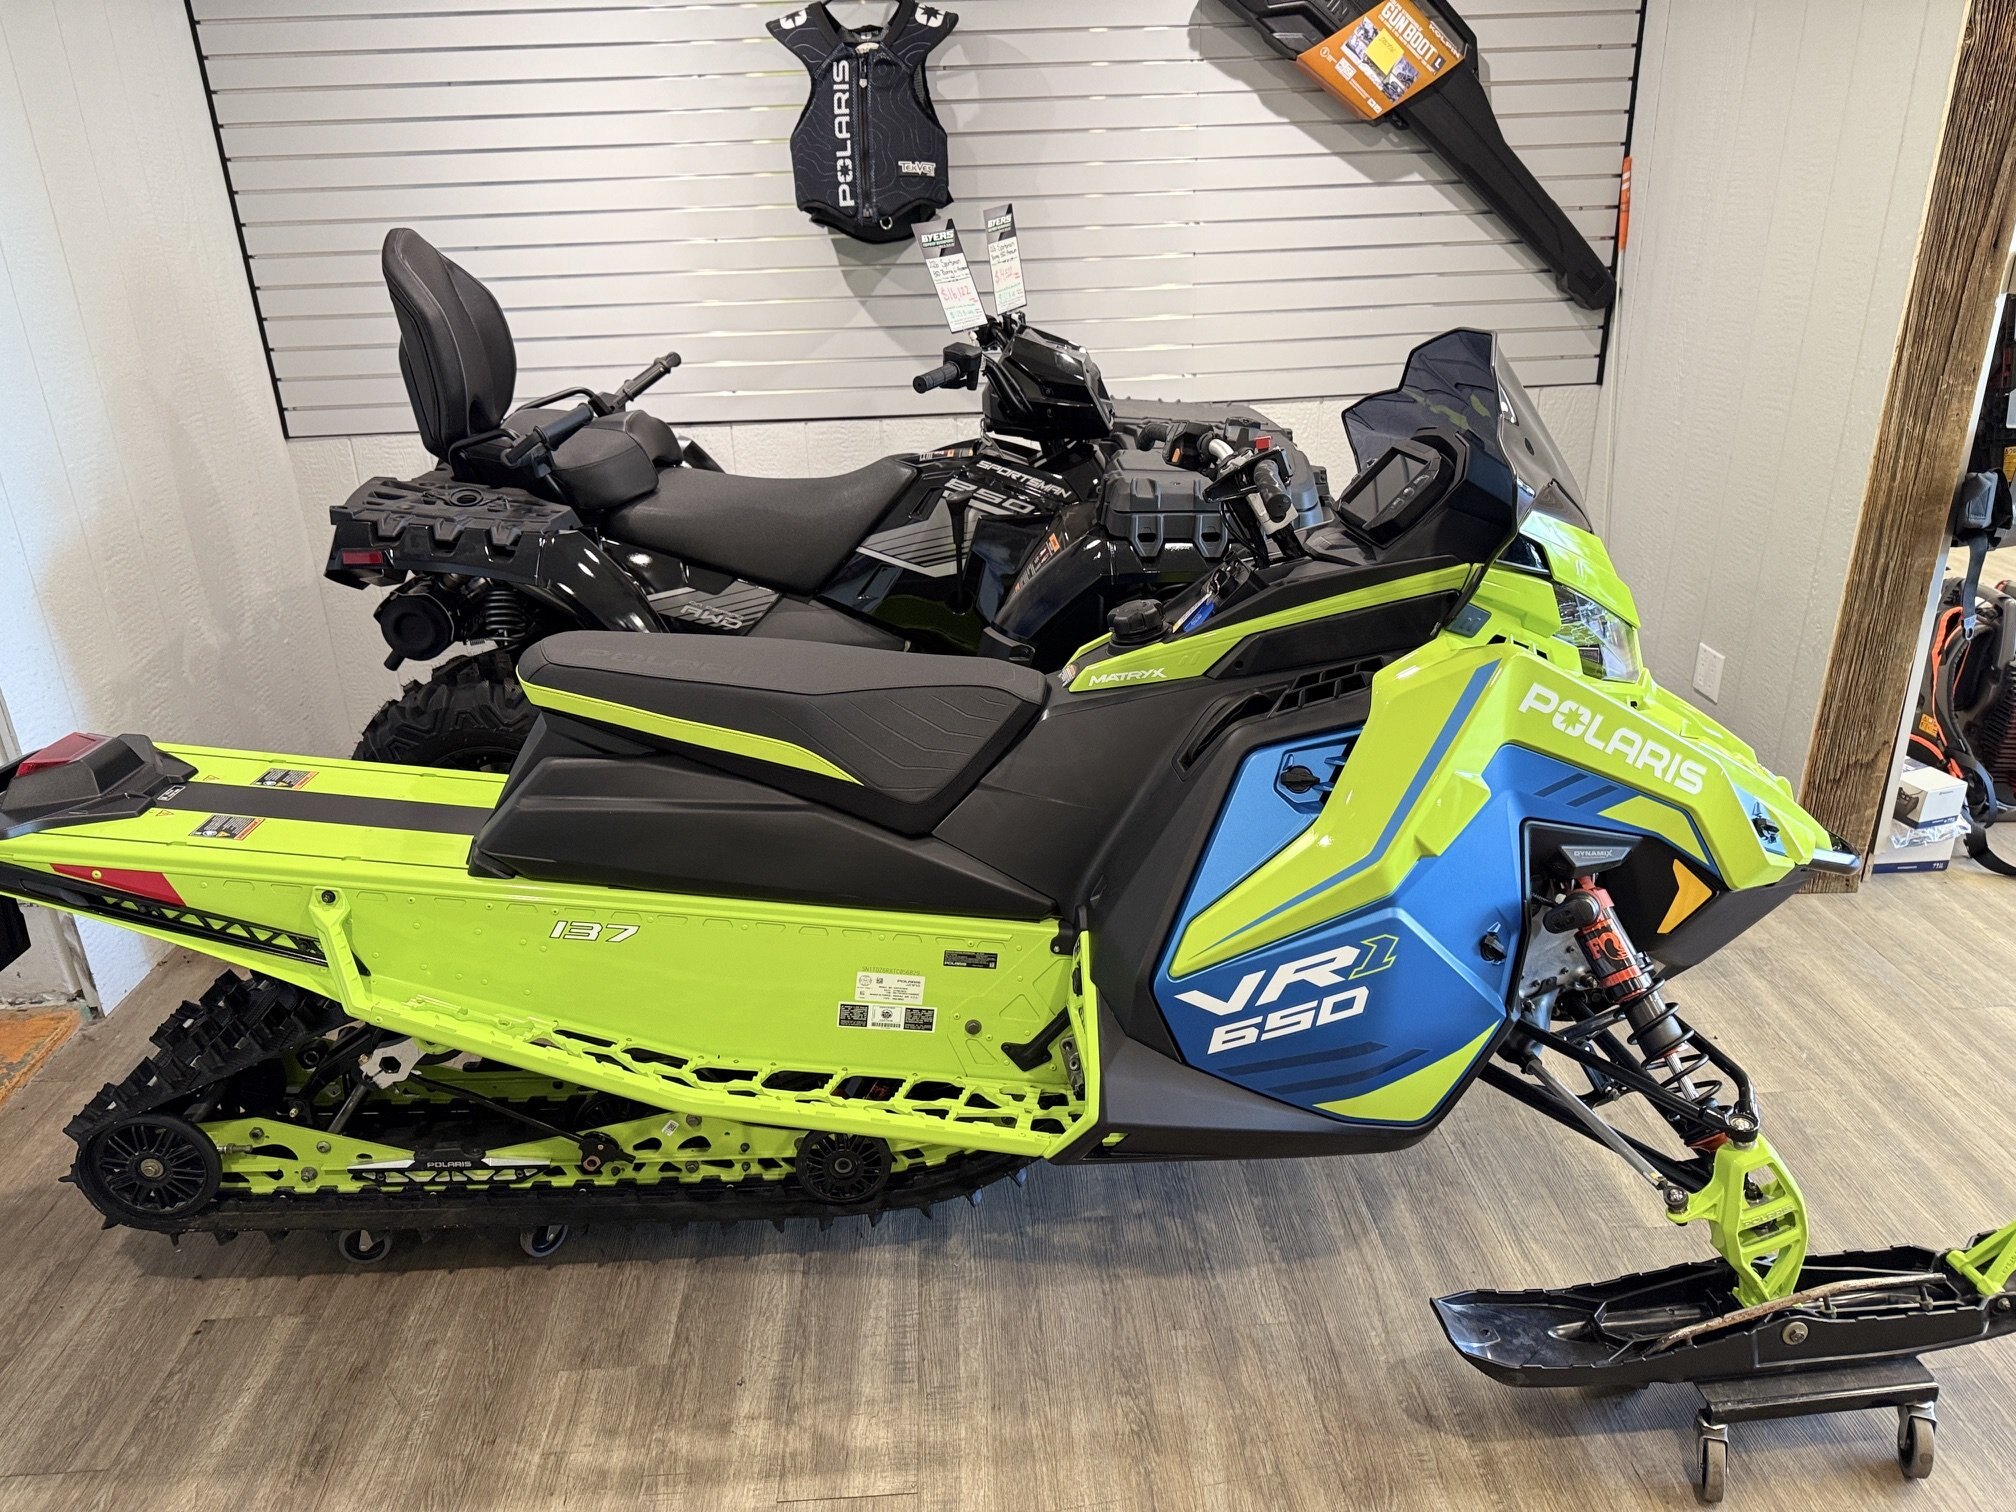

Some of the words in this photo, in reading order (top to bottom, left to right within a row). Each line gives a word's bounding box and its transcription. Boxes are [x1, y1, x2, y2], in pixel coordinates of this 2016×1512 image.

[1381, 1, 1410, 33] GUN
[1402, 23, 1438, 61] BOOT
[1434, 57, 1442, 69] L
[1429, 23, 1460, 60] KOLPIN
[832, 59, 856, 208] POLARIS
[987, 213, 1012, 228] BYERS
[921, 230, 955, 243] BYERS
[976, 460, 1072, 499] SPORTSMAN
[680, 605, 743, 629] AWD
[1088, 667, 1167, 687] MATRYX
[1518, 682, 1708, 795] POLARIS
[1573, 849, 1613, 857] DYNAMIX
[549, 920, 641, 943] 137
[1174, 934, 1399, 1016] VR1
[1207, 985, 1369, 1055] 650
[427, 1160, 472, 1168] POLARIS
